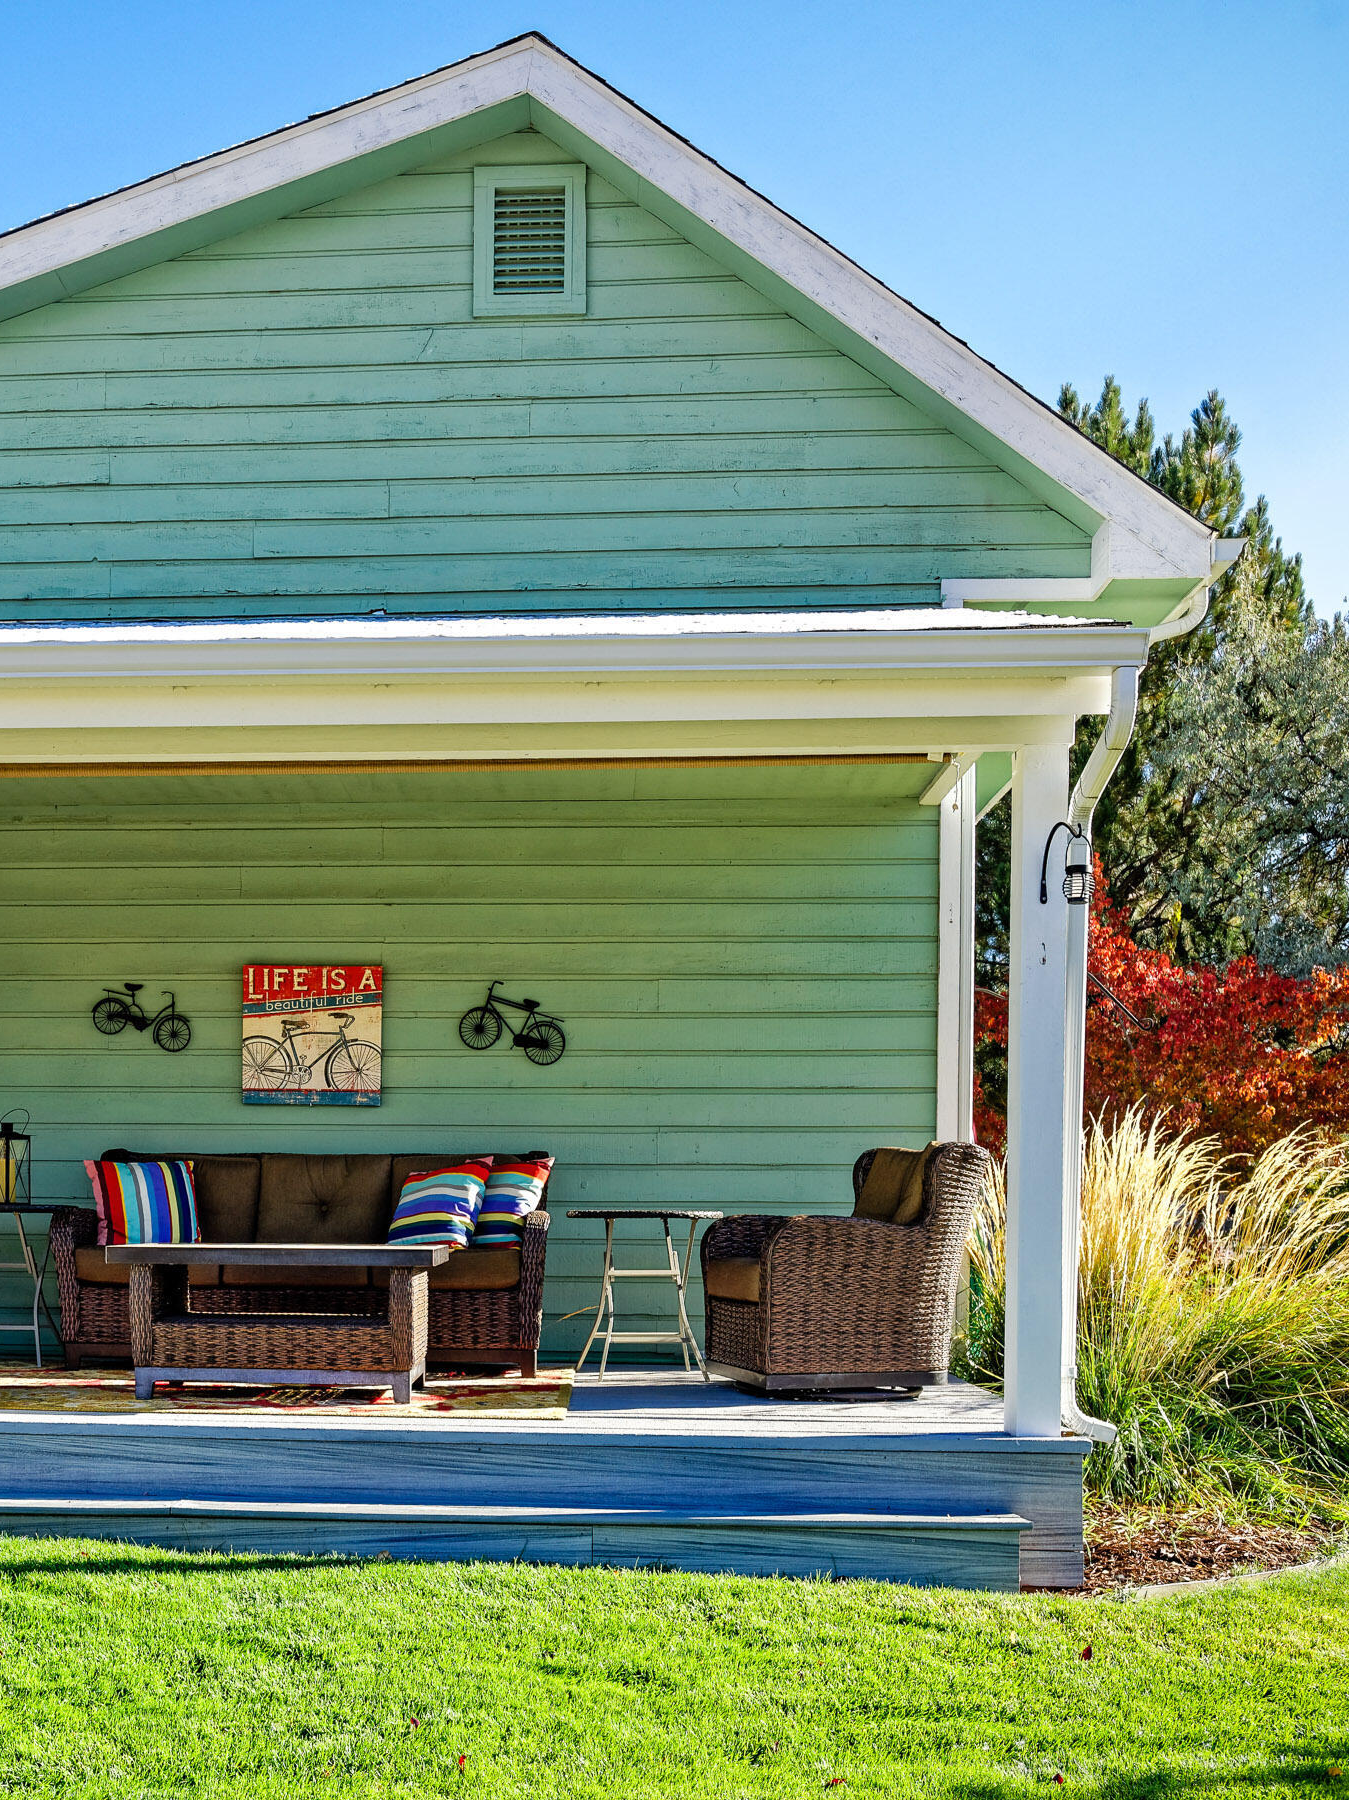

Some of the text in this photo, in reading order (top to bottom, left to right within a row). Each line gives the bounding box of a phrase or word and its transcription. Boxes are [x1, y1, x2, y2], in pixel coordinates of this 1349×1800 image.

[248, 967, 377, 999] LIFE IS A
[265, 987, 364, 1013] beautiful ride
